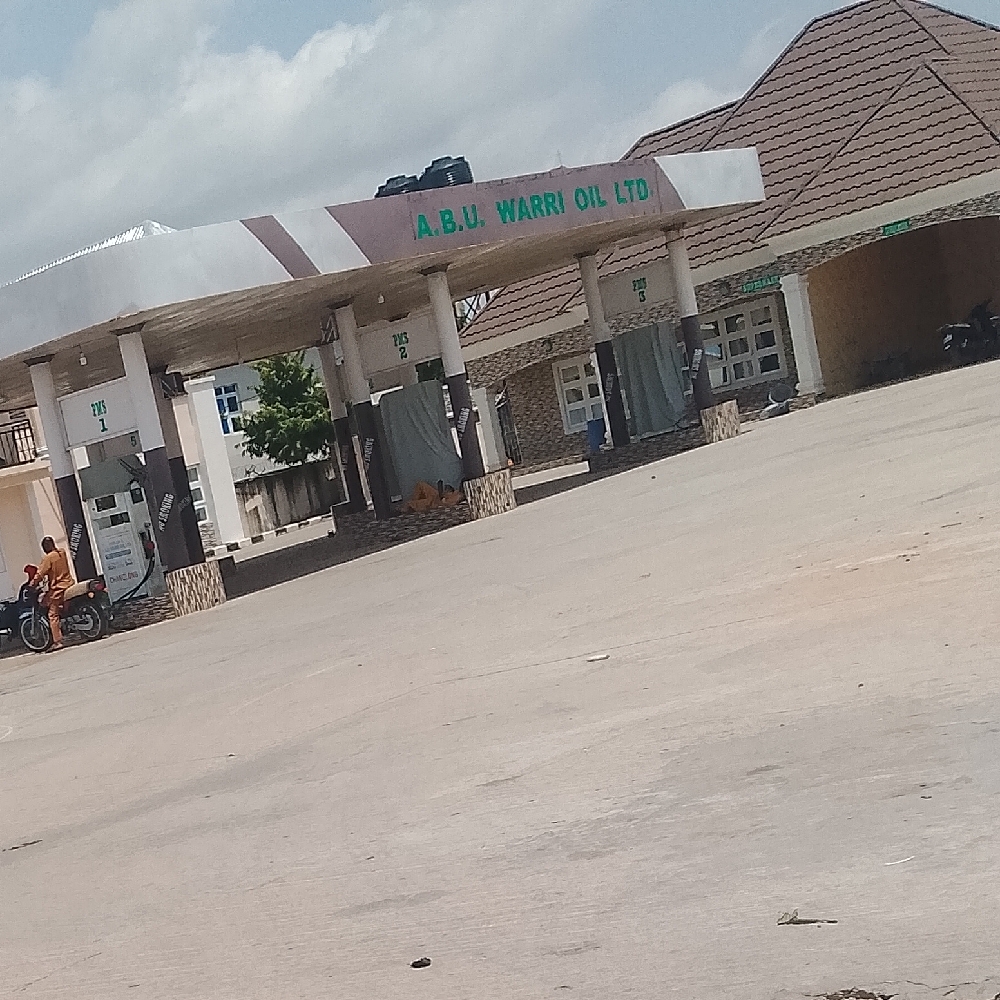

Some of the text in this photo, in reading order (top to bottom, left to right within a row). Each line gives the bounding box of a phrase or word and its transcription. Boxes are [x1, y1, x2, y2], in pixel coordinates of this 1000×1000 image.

[417, 204, 485, 239] A.B.U.
[496, 190, 565, 224] WARRI
[574, 185, 607, 211] OIL
[399, 347, 408, 359] 2
[91, 399, 107, 417] PMS
[98, 418, 108, 432] 1
[159, 493, 175, 522] SMOKING
[70, 523, 83, 551] SMOKING
